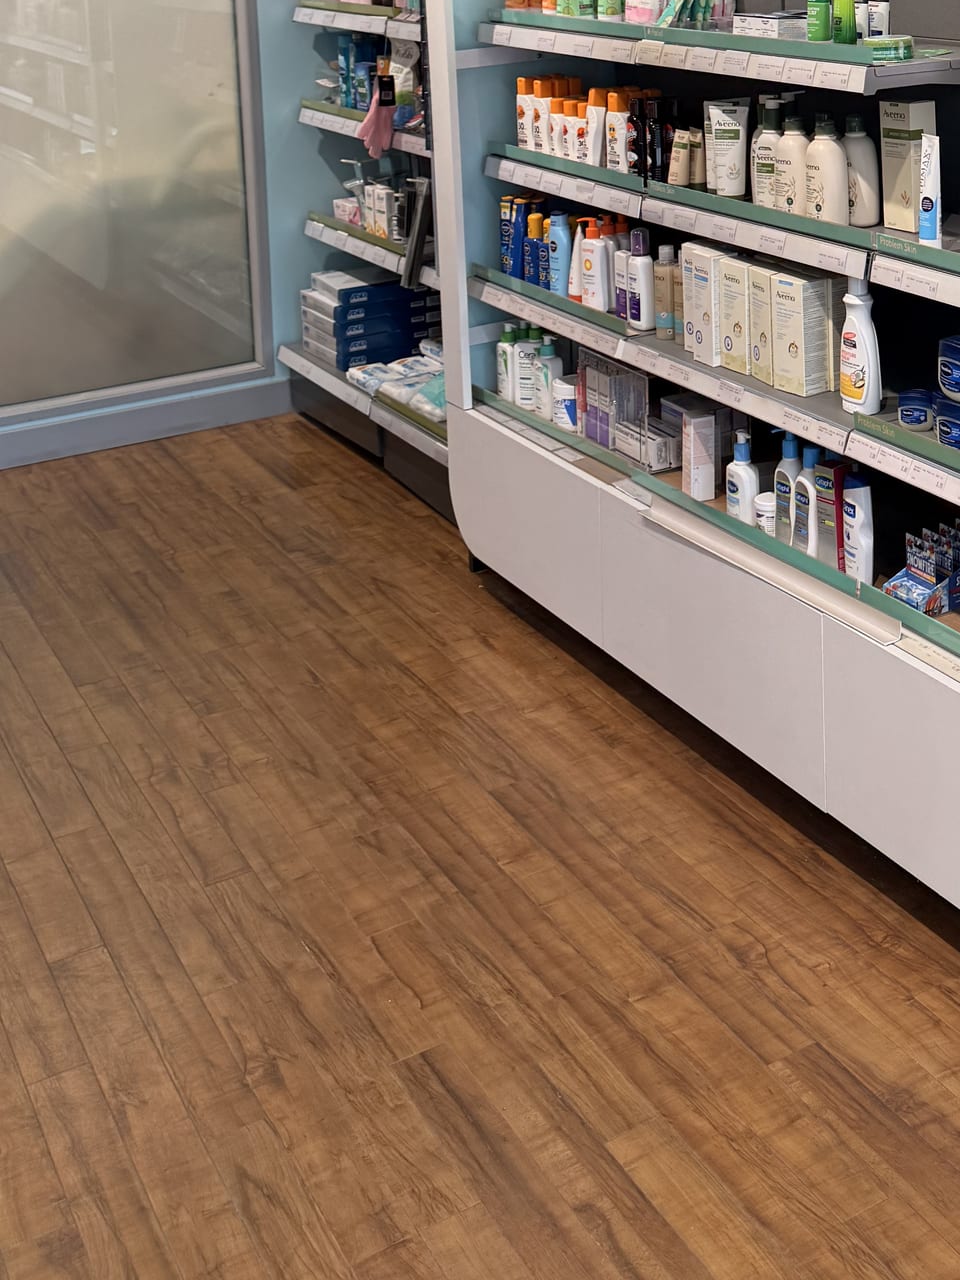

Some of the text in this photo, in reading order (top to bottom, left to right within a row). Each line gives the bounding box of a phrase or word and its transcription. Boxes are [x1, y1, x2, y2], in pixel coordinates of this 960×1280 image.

[883, 110, 905, 120] Aveeno
[776, 290, 796, 302] Aveeno
[907, 552, 935, 576] SNOWFIRE
